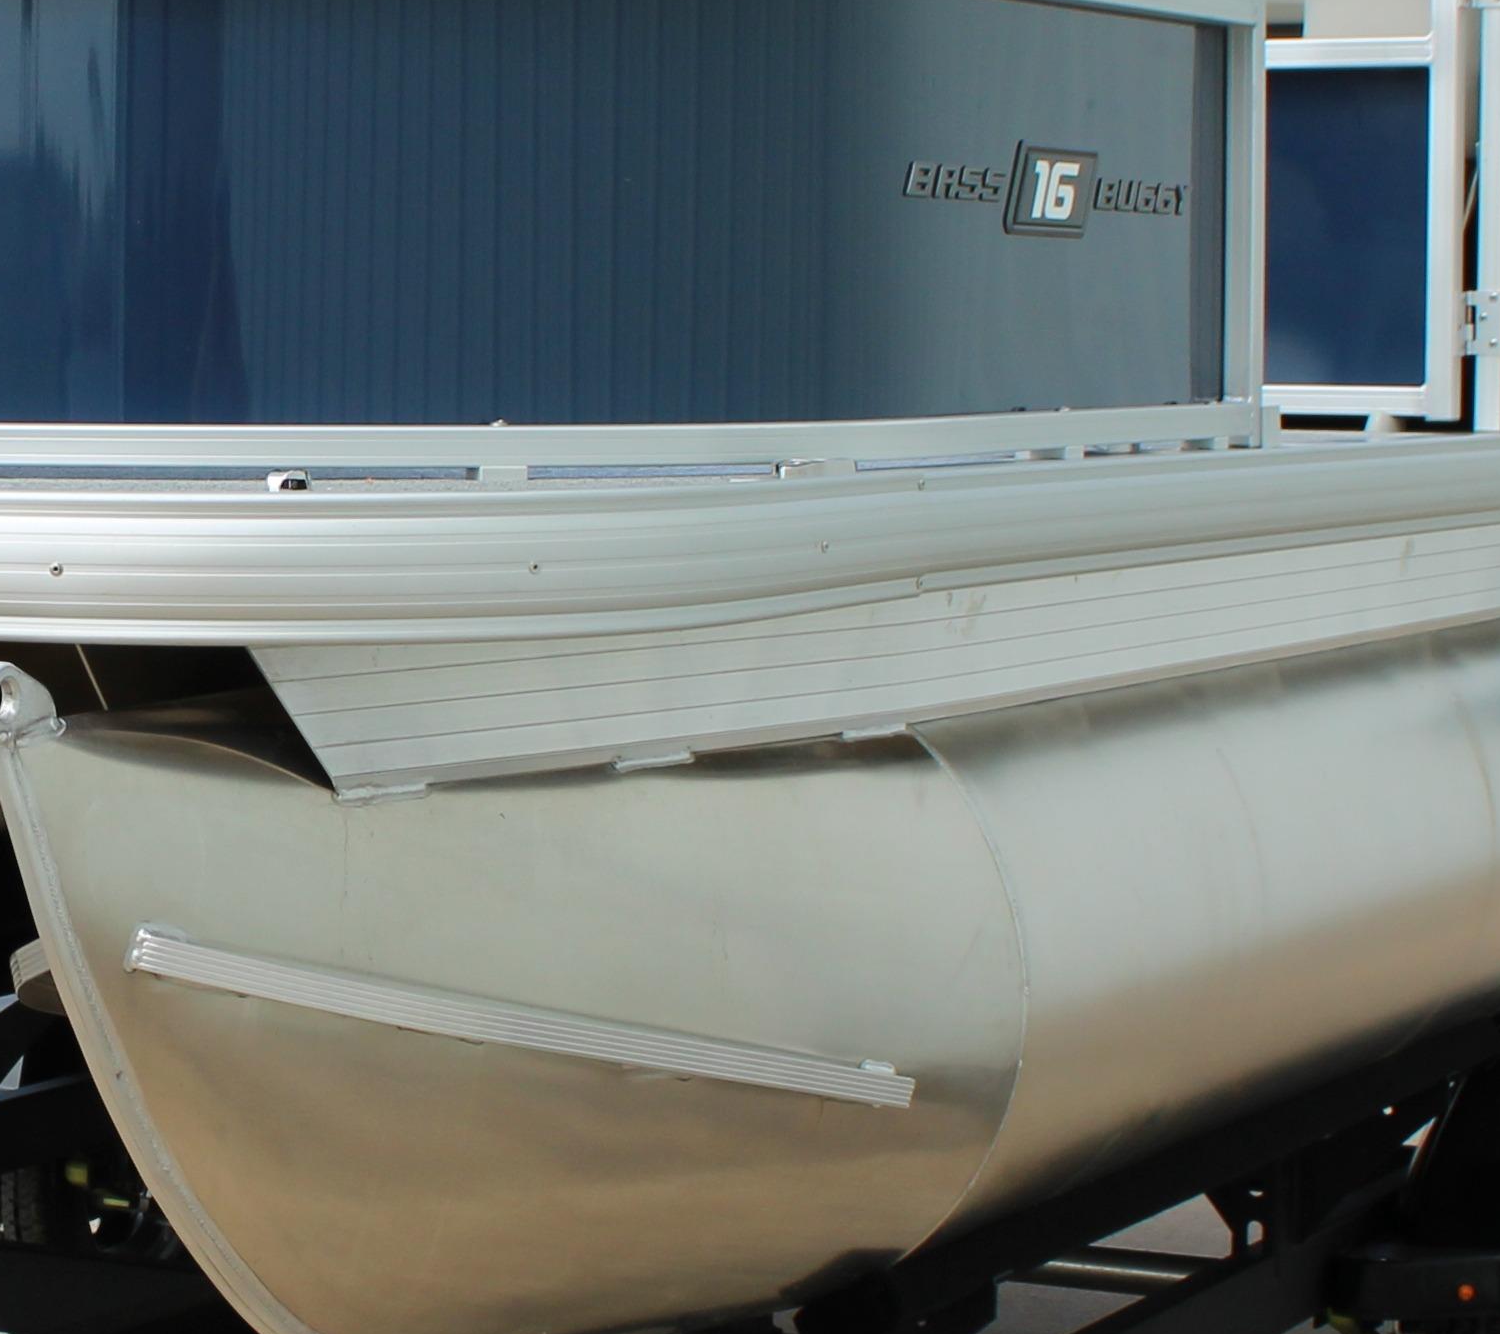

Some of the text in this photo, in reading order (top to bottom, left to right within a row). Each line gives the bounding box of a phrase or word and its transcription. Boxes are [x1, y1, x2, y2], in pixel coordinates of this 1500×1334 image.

[902, 158, 1190, 221] BASS 16 BUGGY
